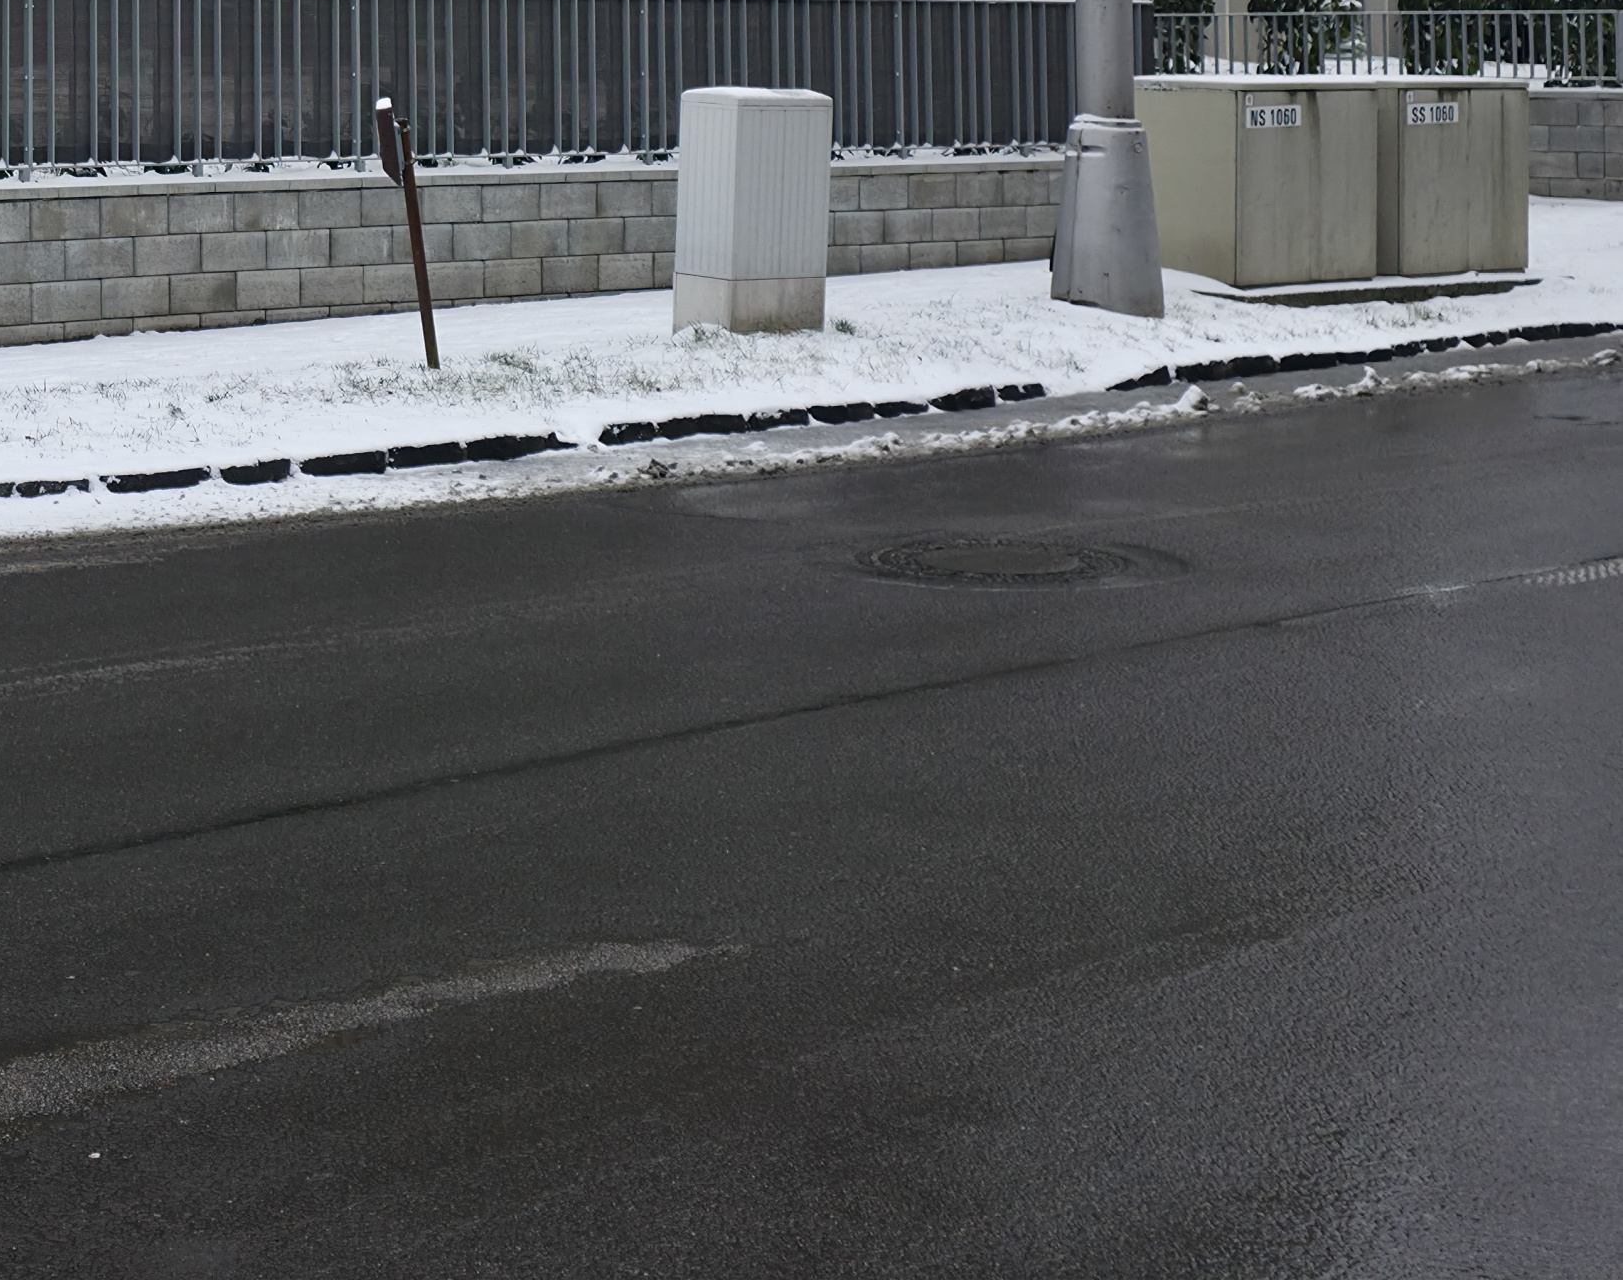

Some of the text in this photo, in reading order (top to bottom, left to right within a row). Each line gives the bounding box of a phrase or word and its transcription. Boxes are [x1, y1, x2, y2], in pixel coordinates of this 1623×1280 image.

[1250, 107, 1297, 126] NS 1060
[1411, 105, 1454, 123] SS 1060
